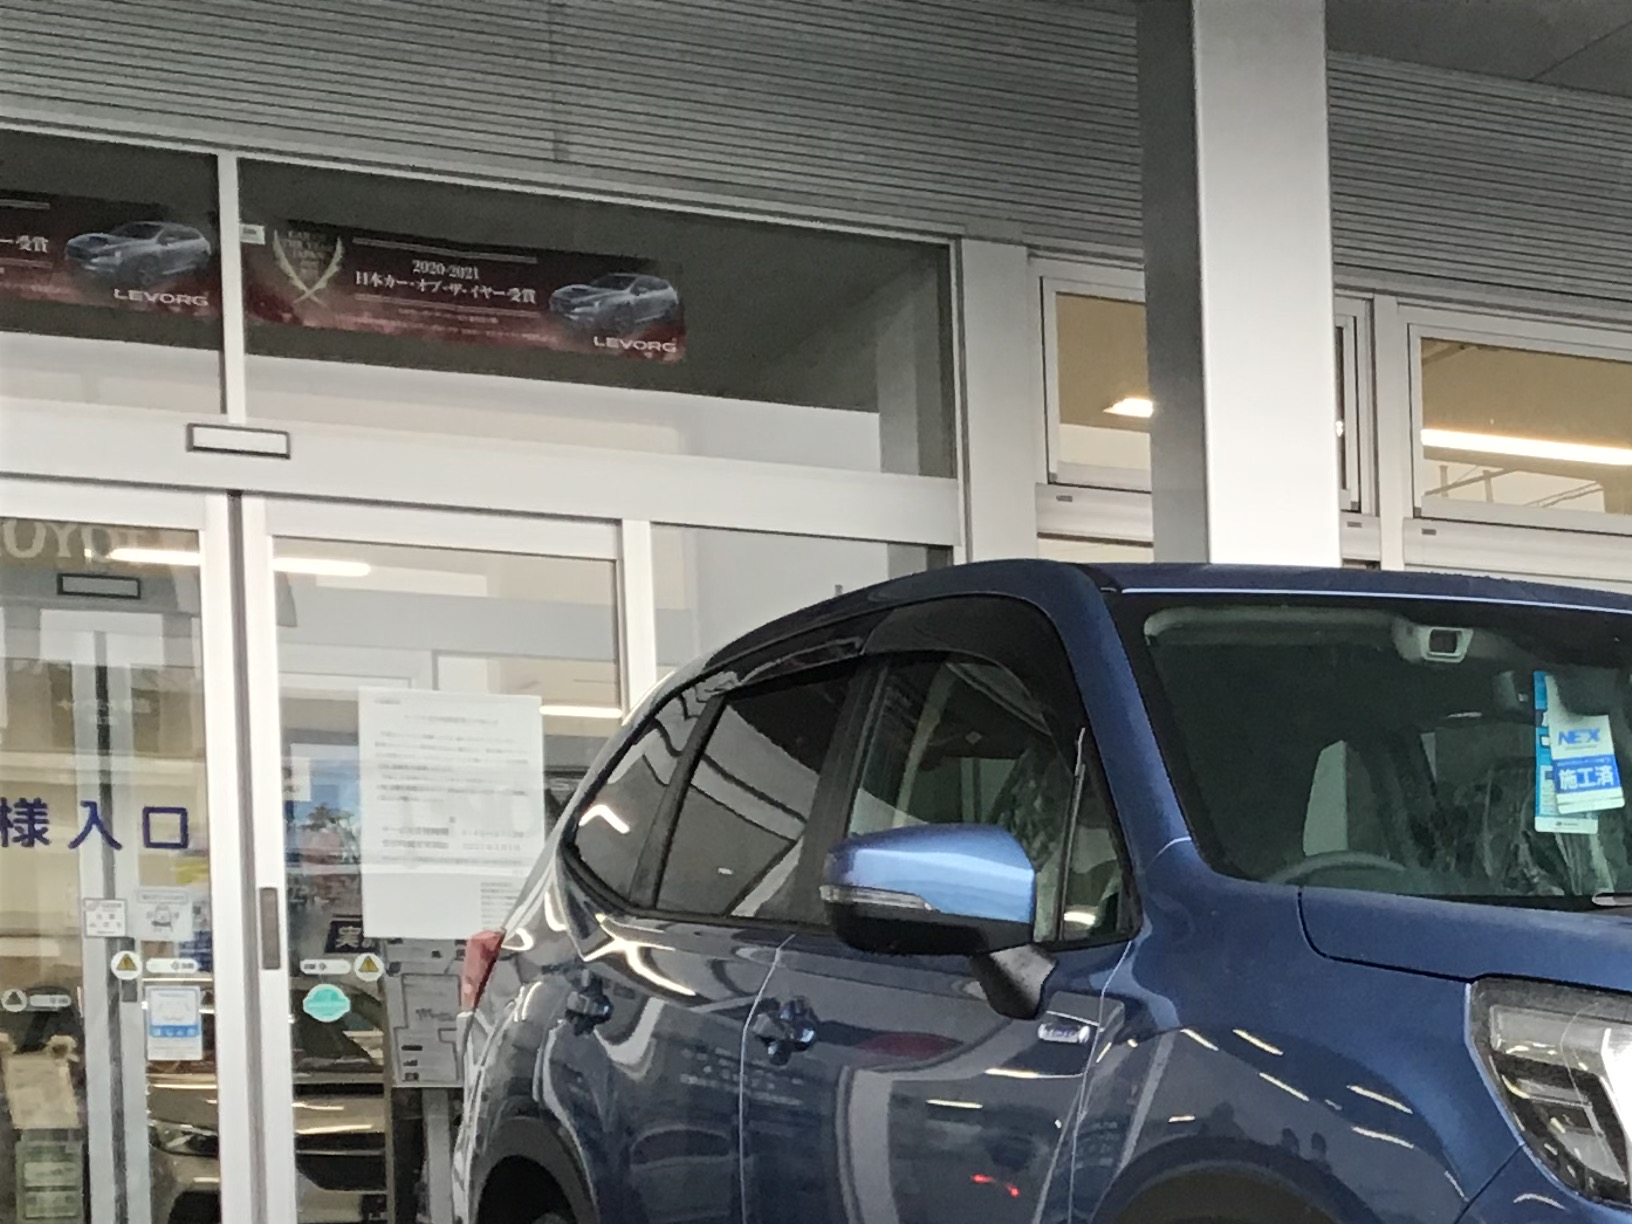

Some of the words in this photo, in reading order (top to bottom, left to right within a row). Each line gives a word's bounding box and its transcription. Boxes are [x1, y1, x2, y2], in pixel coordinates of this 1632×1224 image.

[113, 288, 209, 307] LEVORG
[592, 335, 677, 354] LEVORG
[1557, 764, 1615, 792] 施工済
[0, 797, 189, 850] 様入口
